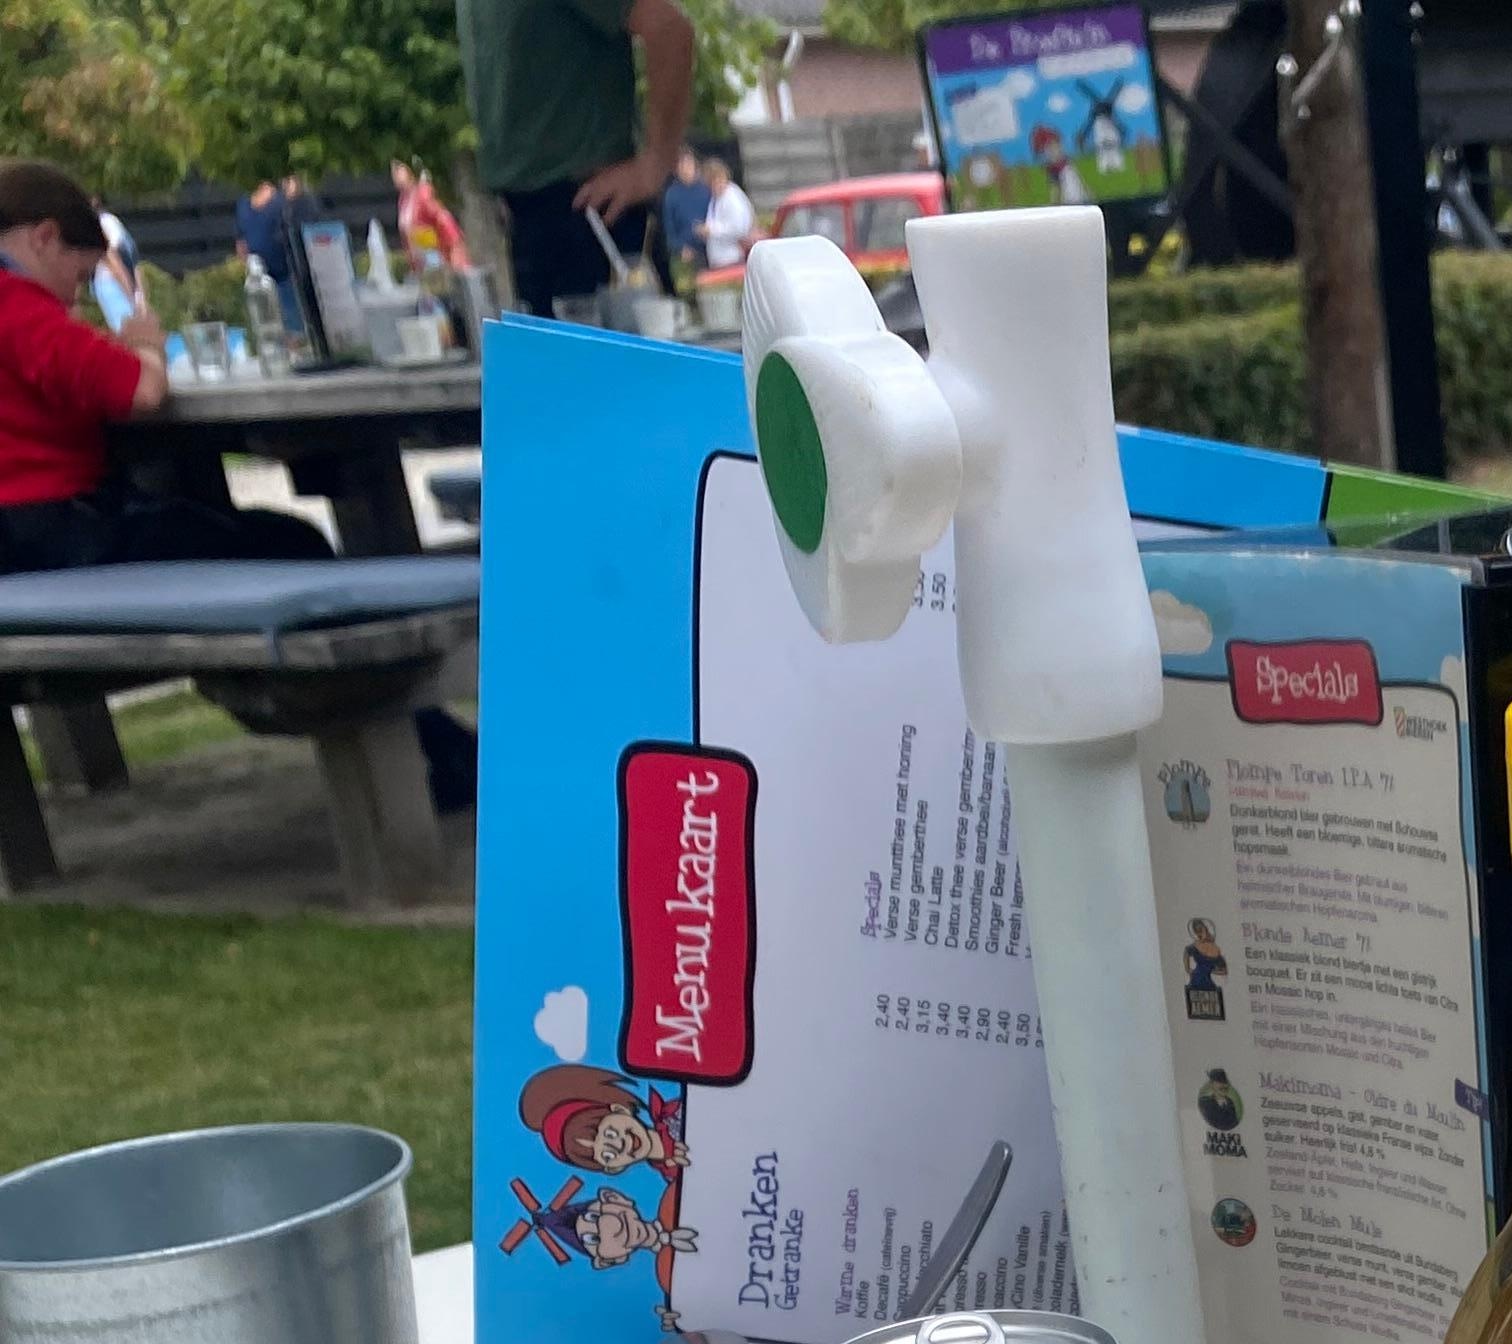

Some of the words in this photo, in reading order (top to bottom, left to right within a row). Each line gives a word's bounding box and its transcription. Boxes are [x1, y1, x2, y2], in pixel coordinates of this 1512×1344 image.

[1256, 655, 1359, 705] Specials
[899, 724, 917, 779] honing
[896, 783, 909, 813] met
[911, 800, 928, 894] gemberthee
[955, 817, 968, 859] verse
[1265, 824, 1293, 840] Heeft
[1296, 828, 1315, 840] een
[891, 817, 906, 890] muntthee
[928, 866, 943, 906] Latte
[949, 864, 964, 899] thee
[990, 861, 1007, 898] Beer
[656, 770, 720, 1063] Menukaart
[884, 895, 900, 940] Verse
[904, 898, 920, 942] Verse
[925, 908, 941, 945] Chai
[945, 903, 961, 949] Detox
[965, 869, 985, 951] Smoothies
[985, 901, 1004, 954] Ginger
[1005, 910, 1022, 956] Fresh
[1245, 946, 1266, 960] Een
[875, 994, 890, 1028] 2,40
[896, 997, 910, 1031] 2,40
[916, 999, 931, 1033] 3,15
[936, 1002, 951, 1036] 3,40
[956, 1005, 970, 1039] 3,40
[976, 1008, 991, 1041] 2,90
[996, 1011, 1011, 1044] 2,40
[1016, 1013, 1031, 1047] 3,50
[1204, 1143, 1248, 1159] MOMA
[1206, 1131, 1241, 1146] MAKI
[738, 1151, 779, 1309] Dranken
[843, 1188, 859, 1253] dranken
[1014, 1225, 1031, 1270] Vanille
[835, 1262, 856, 1315] Warme
[855, 1281, 870, 1320] Koffie
